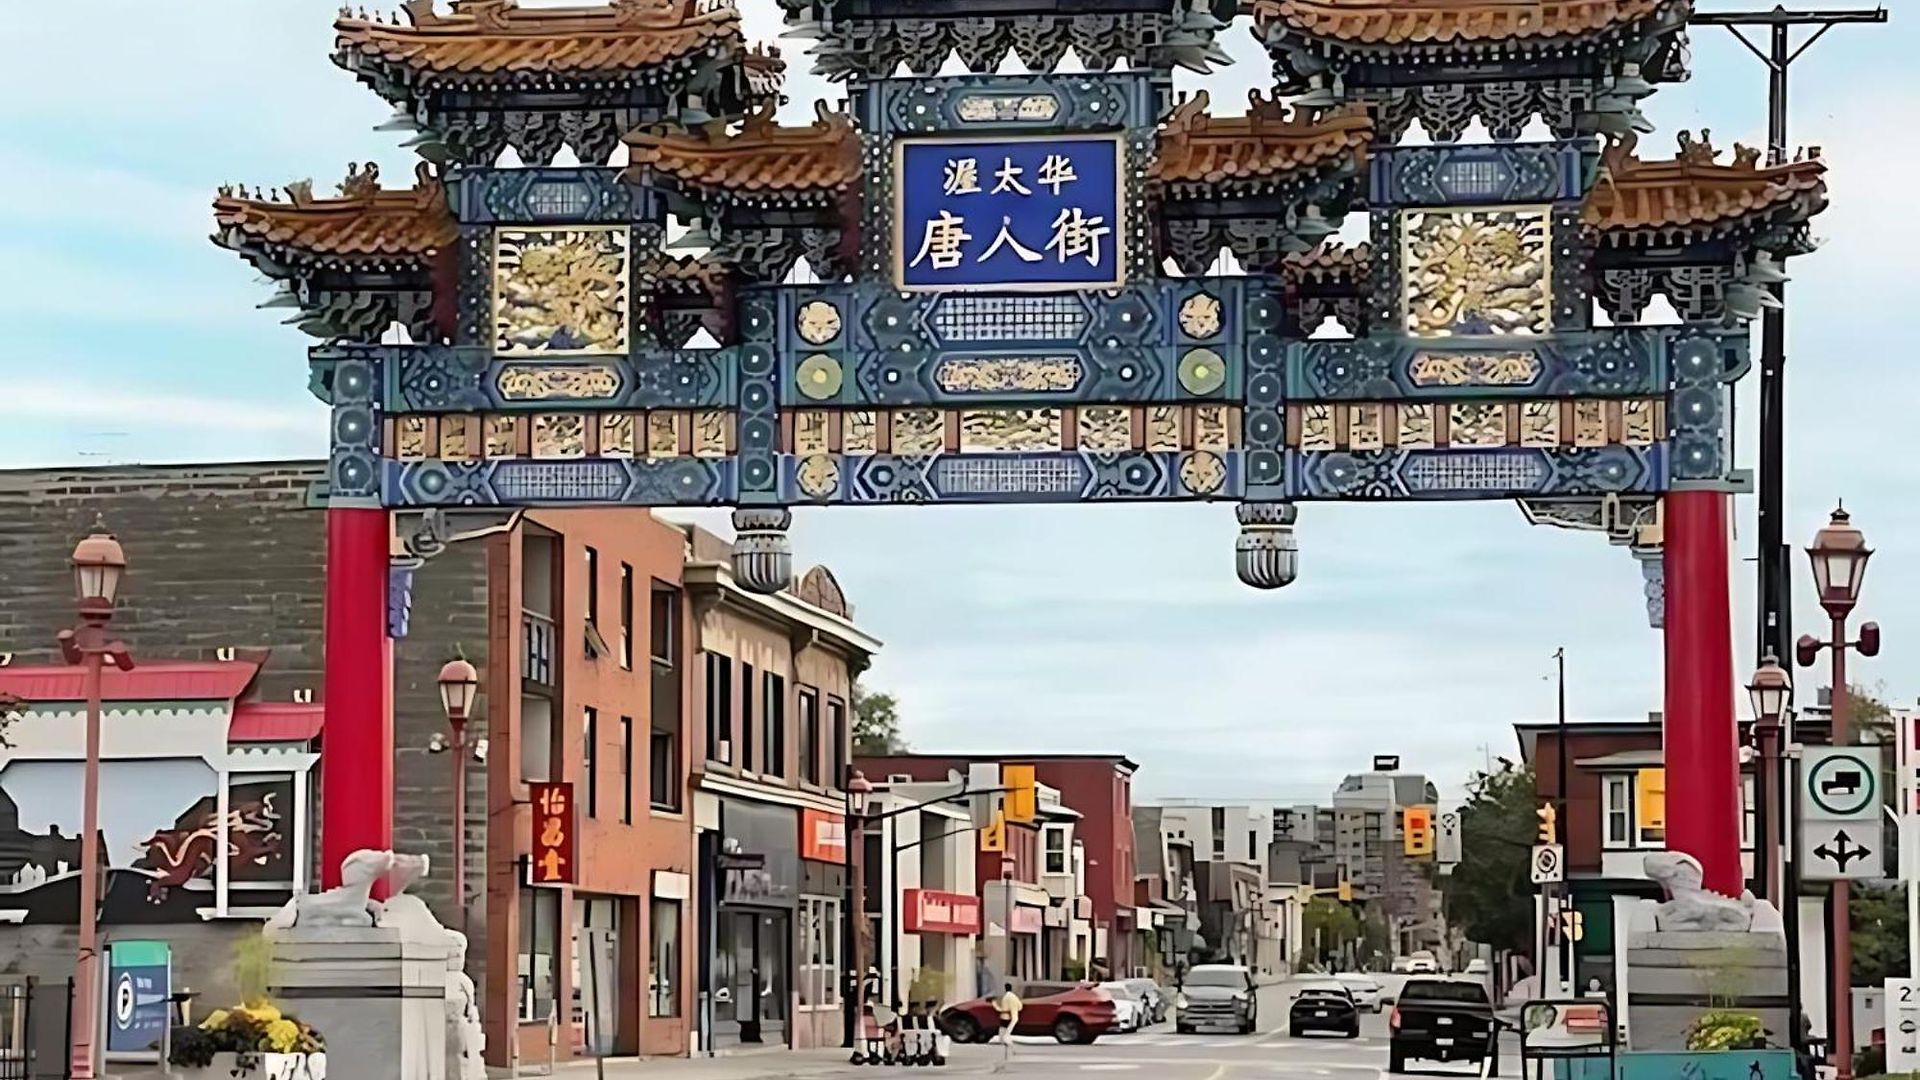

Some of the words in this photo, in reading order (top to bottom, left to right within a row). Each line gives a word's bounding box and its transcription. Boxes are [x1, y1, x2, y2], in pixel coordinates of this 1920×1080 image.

[943, 154, 1078, 196] 渥太华
[909, 207, 1111, 270] 唐人街
